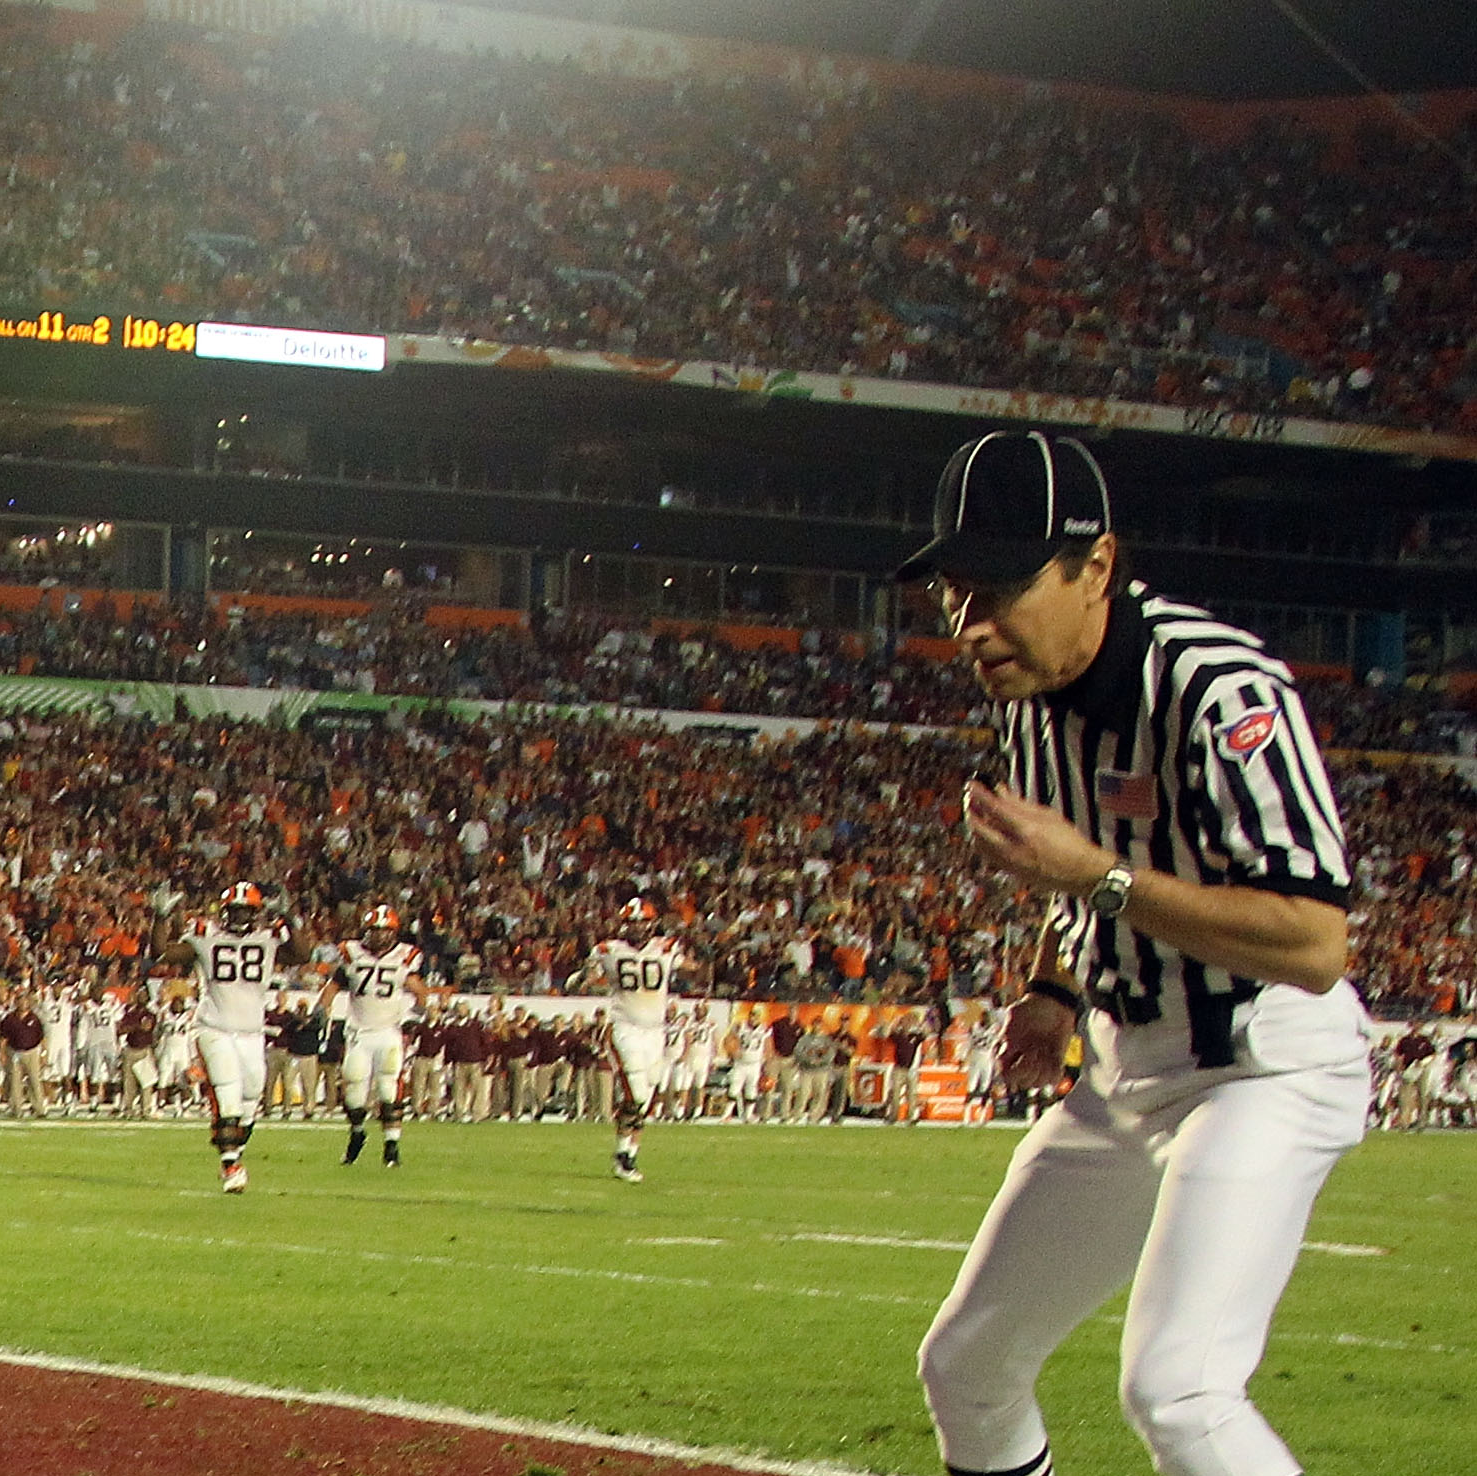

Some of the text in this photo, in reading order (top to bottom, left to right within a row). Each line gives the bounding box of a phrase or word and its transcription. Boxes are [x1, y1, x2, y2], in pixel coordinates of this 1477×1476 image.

[37, 310, 65, 341] 11
[92, 315, 112, 346] 2
[132, 317, 196, 352] 10:24
[283, 337, 368, 361] Deloitte
[212, 943, 266, 984] 68
[616, 957, 665, 992] 60
[354, 965, 396, 999] 75
